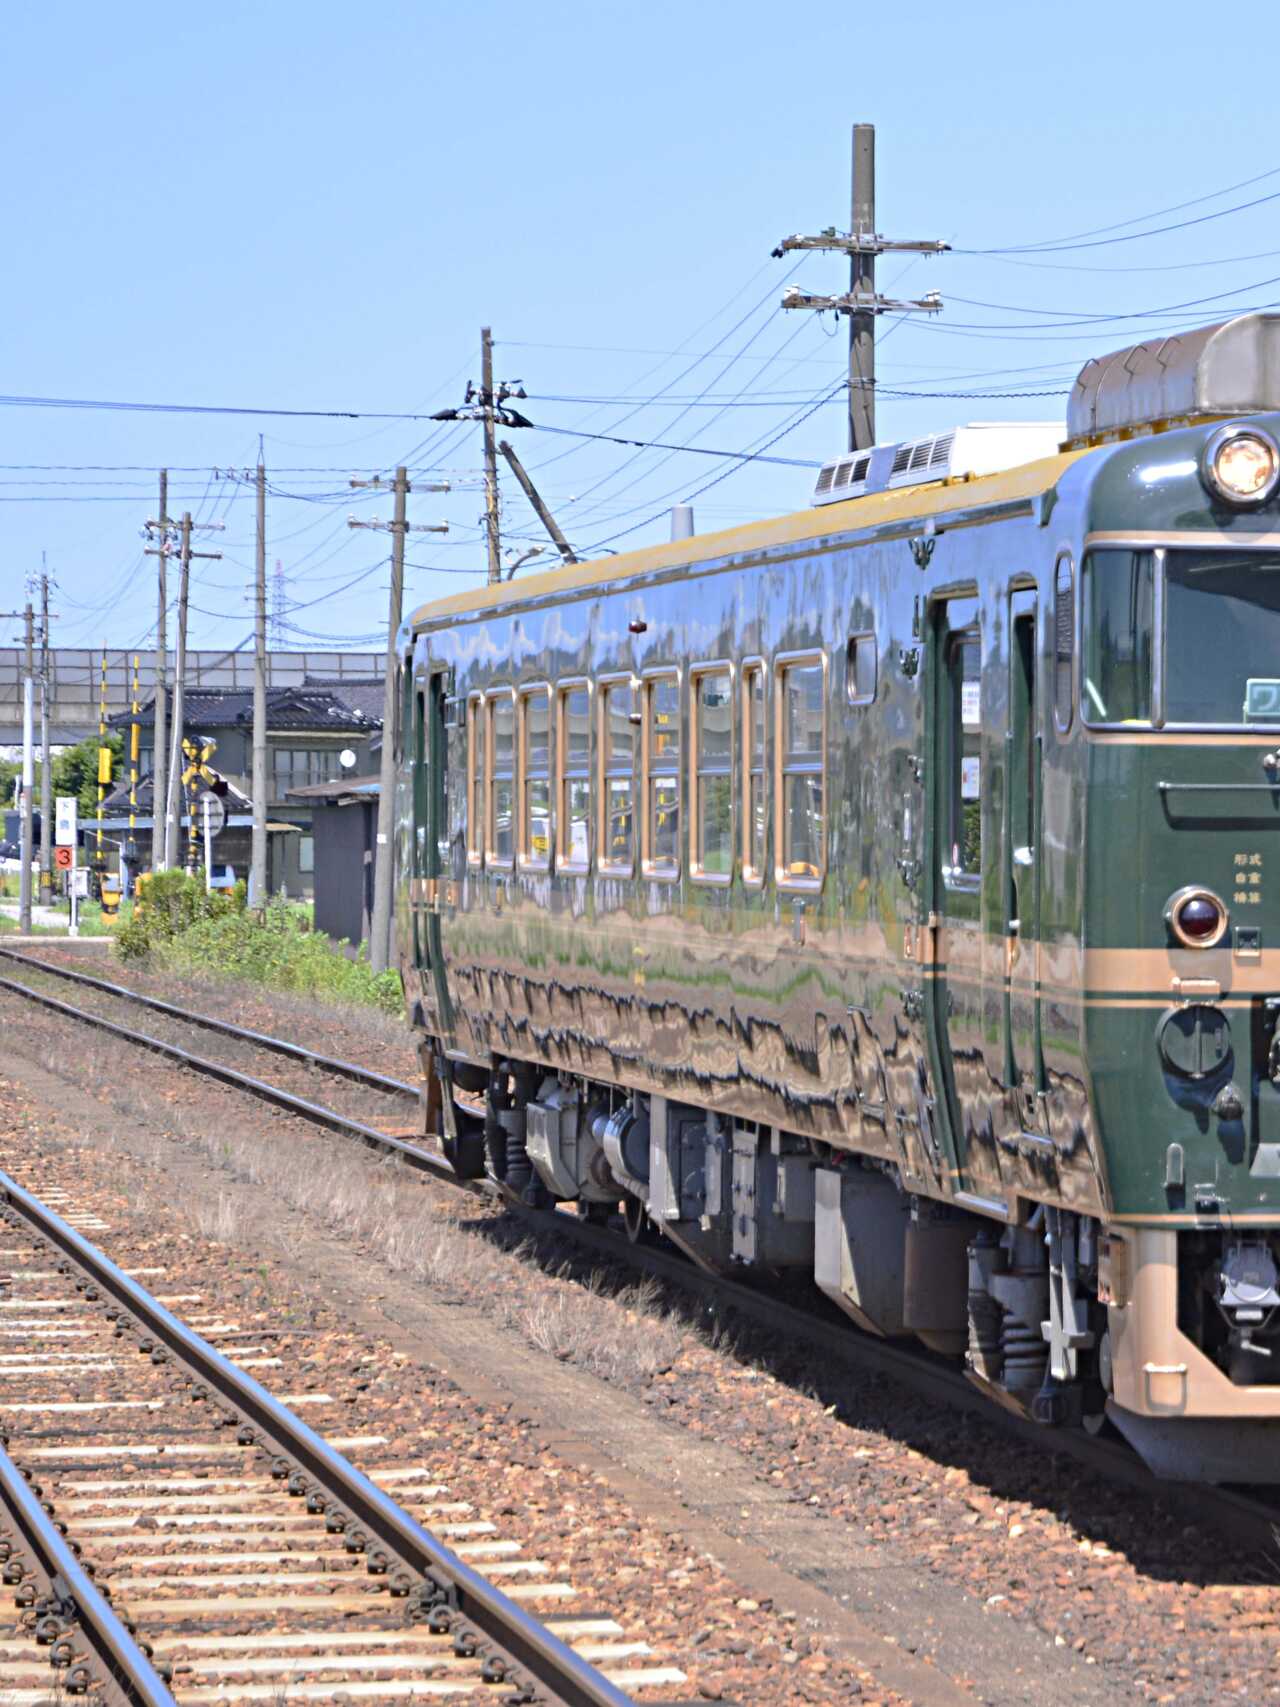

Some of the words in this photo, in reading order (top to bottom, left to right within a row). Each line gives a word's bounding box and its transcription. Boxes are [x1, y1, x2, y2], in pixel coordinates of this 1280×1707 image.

[58, 849, 71, 865] 3
[1233, 853, 1262, 866] 形式
[1234, 872, 1262, 884] 自重
